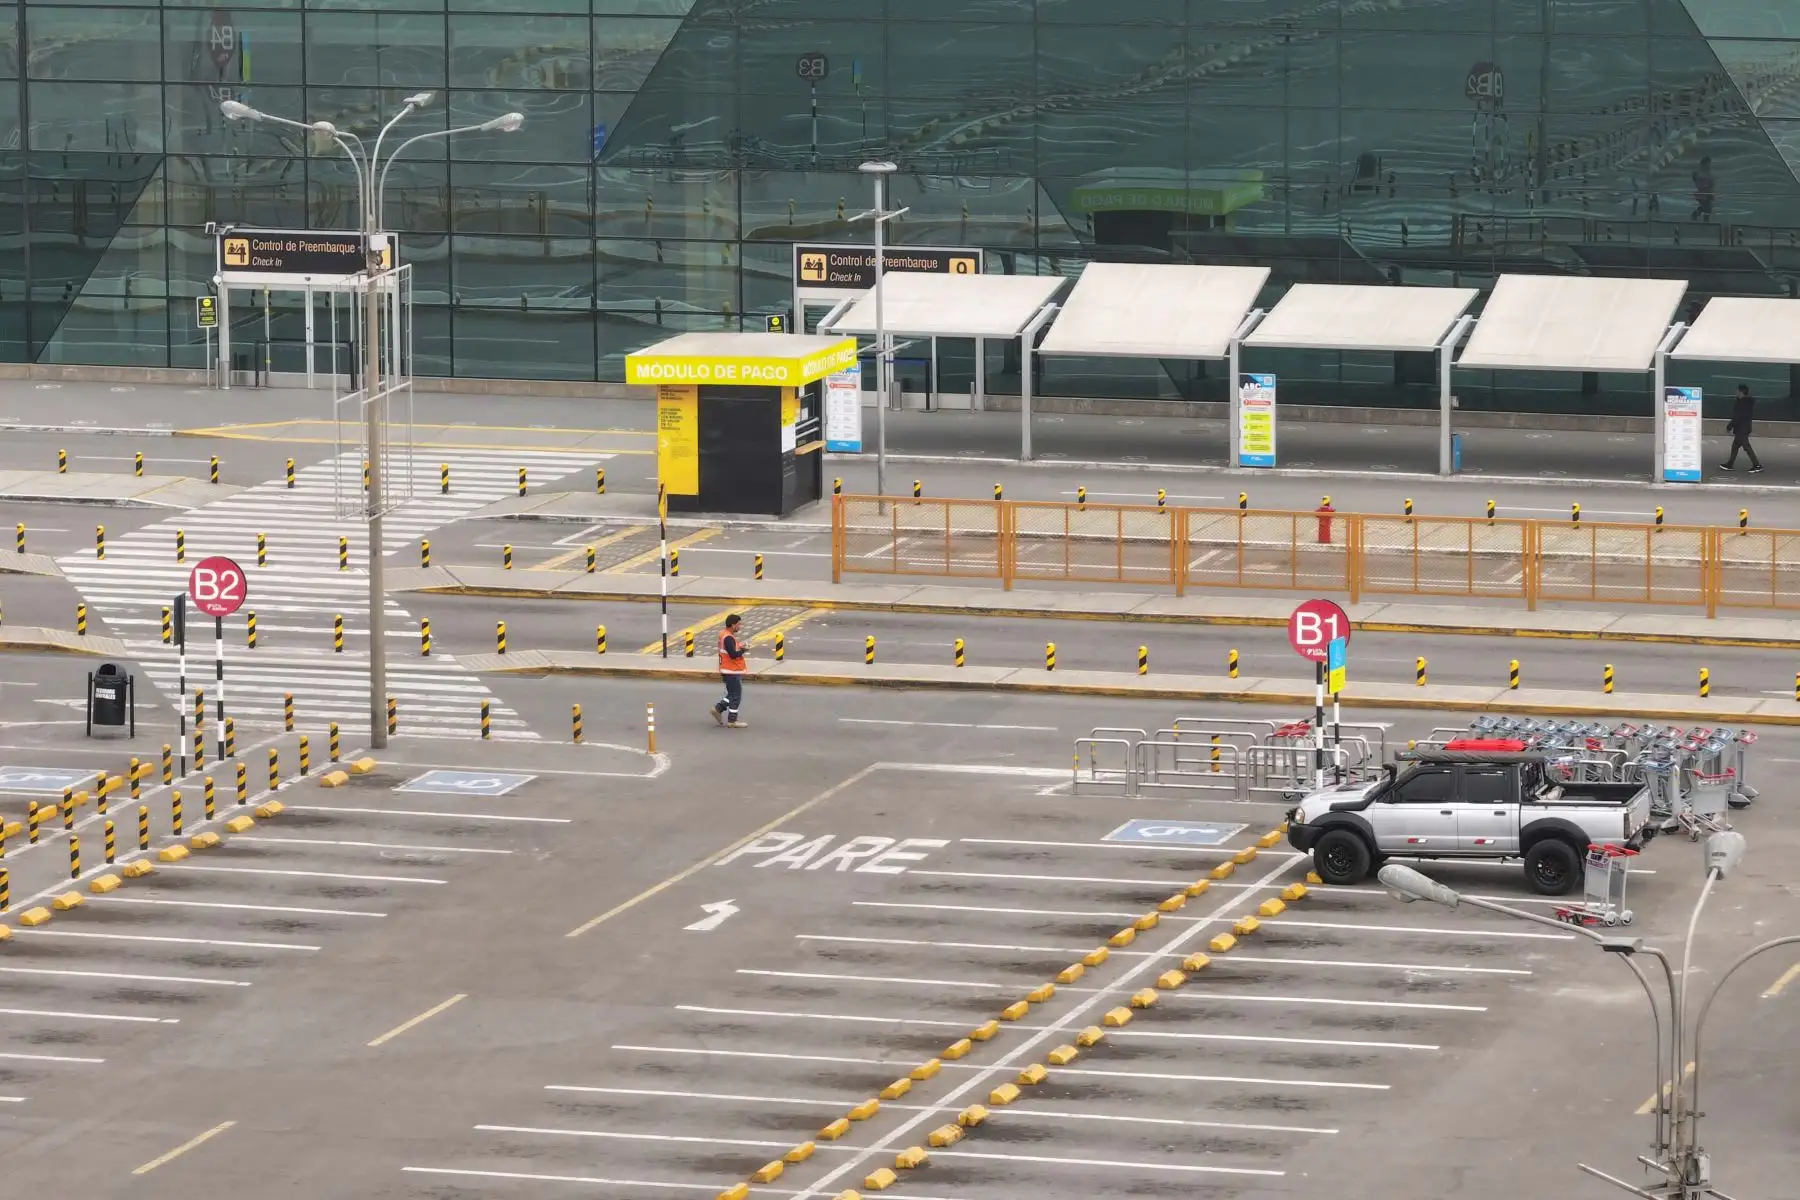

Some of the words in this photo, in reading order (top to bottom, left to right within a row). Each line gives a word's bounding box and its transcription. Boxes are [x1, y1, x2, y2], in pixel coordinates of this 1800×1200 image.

[252, 239, 283, 251] Control
[285, 240, 297, 251] de
[299, 240, 356, 255] Preembarque
[252, 257, 274, 266] Check
[275, 259, 283, 267] In
[830, 253, 863, 267] Control
[865, 255, 876, 267] de
[830, 271, 852, 282] Check
[854, 273, 862, 282] In
[636, 360, 710, 379] MÓDULO
[715, 364, 737, 379] DE
[741, 365, 788, 380] PAGO
[195, 568, 240, 600] B2
[1296, 611, 1338, 645] B1
[713, 831, 952, 875] PARE
